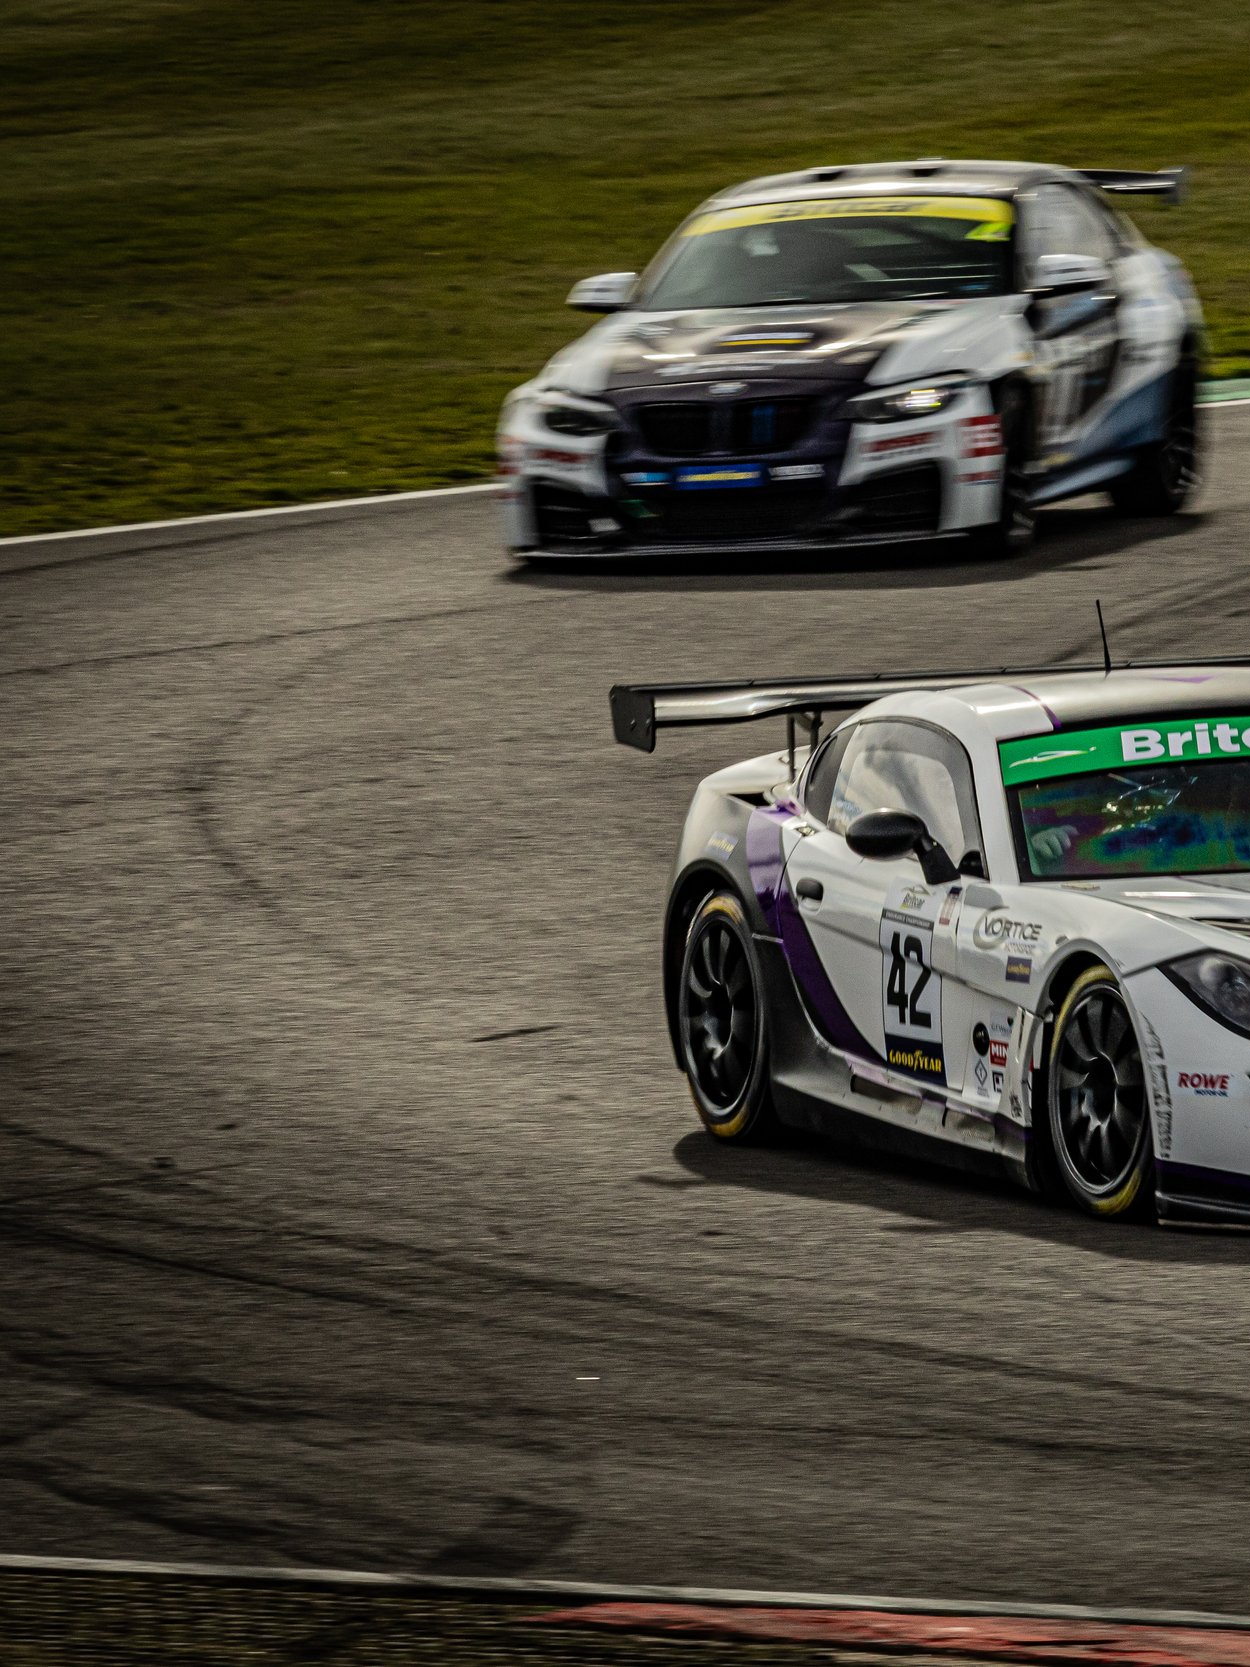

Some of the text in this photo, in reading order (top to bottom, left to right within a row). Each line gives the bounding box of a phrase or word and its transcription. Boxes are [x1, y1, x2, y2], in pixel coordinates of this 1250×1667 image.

[984, 915, 1043, 941] VORTICE
[887, 931, 932, 1029] 42
[889, 1049, 942, 1073] GOODYEAR
[1178, 1072, 1230, 1090] ROWE
